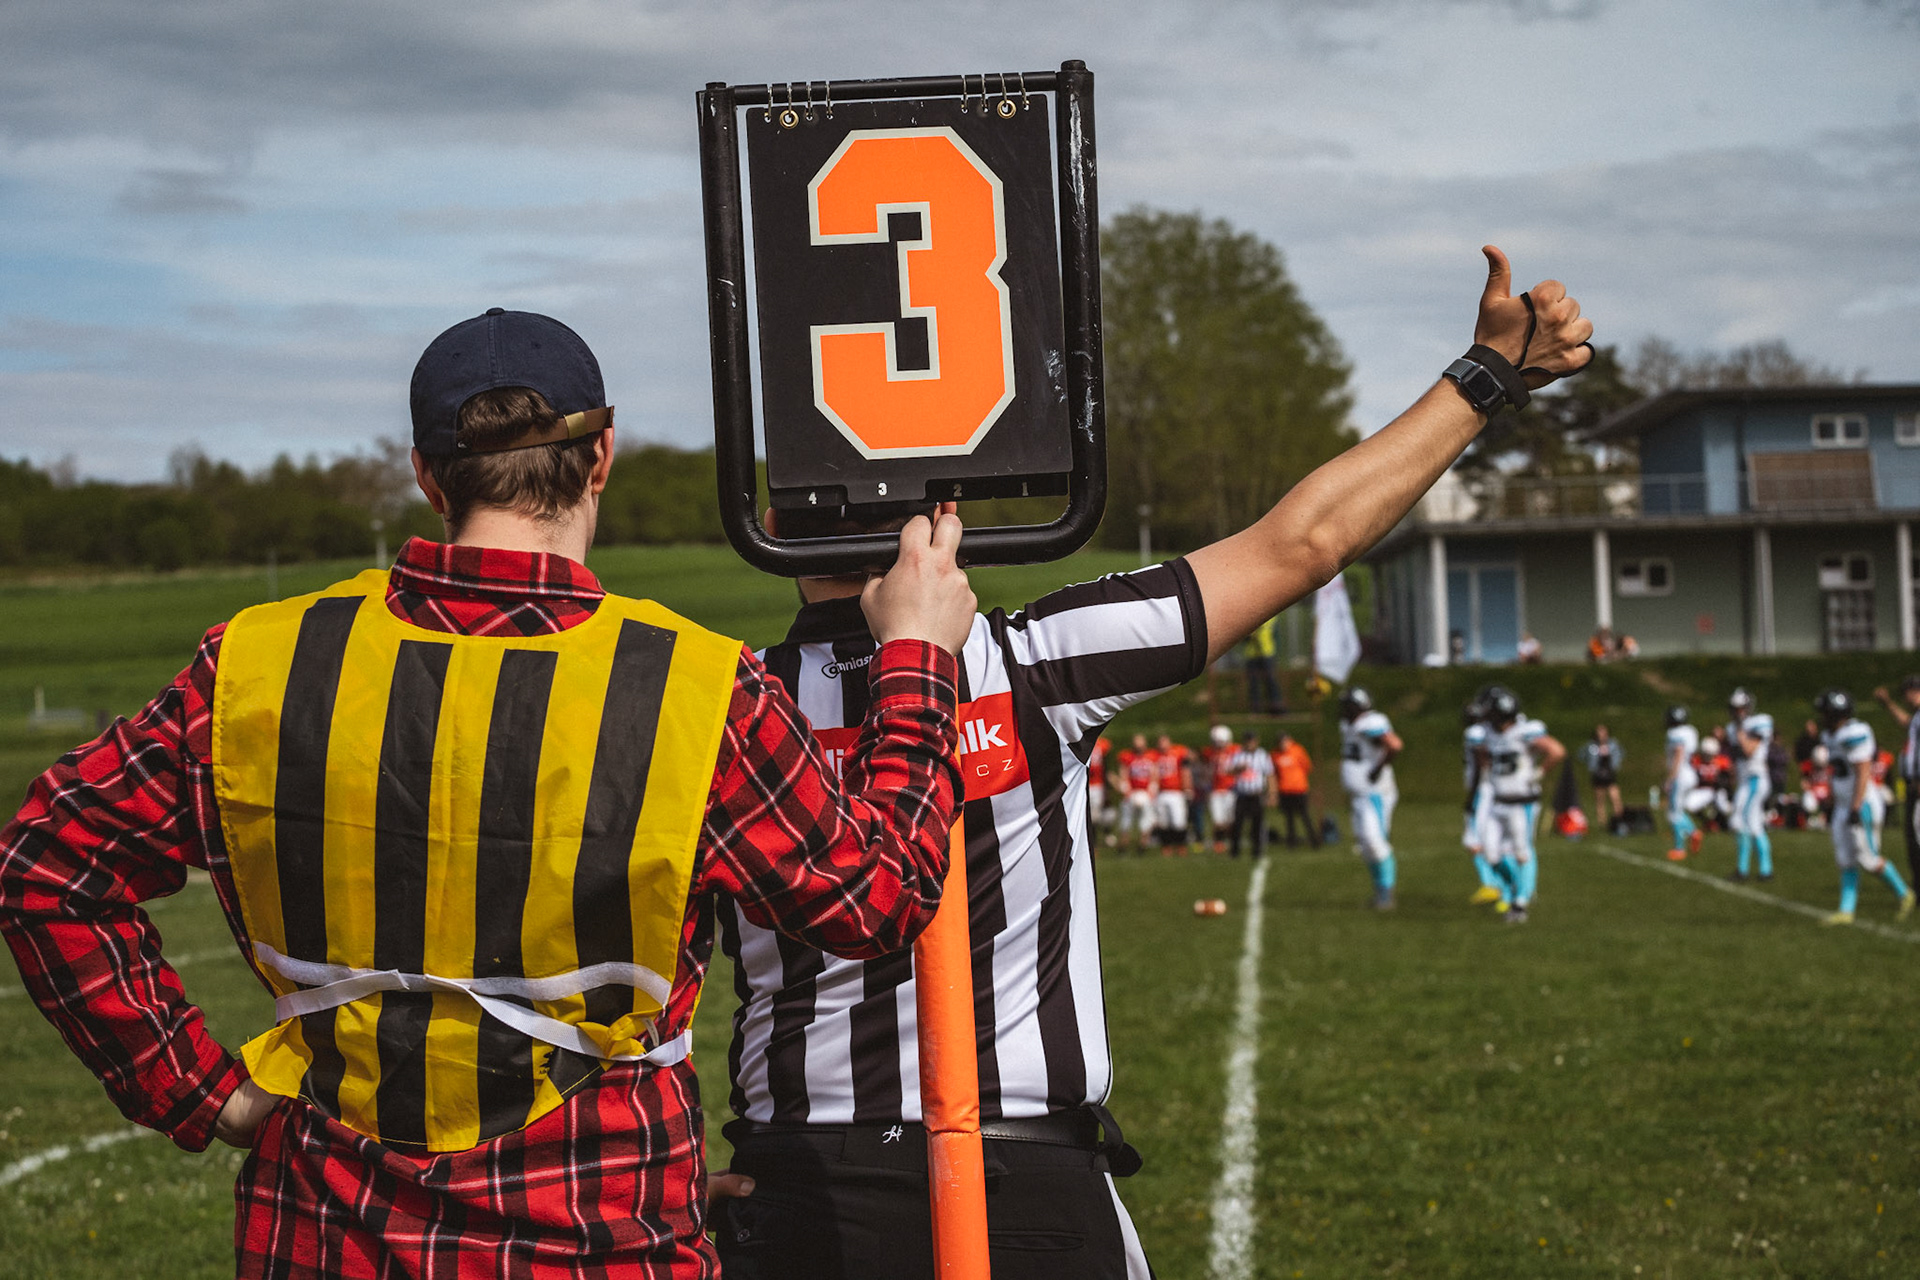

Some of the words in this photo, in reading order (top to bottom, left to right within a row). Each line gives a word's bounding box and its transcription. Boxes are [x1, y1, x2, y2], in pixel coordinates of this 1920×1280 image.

[808, 126, 1016, 460] 3
[808, 491, 818, 505] 4
[877, 482, 888, 496] 3
[953, 483, 963, 497] 2
[1021, 482, 1029, 496] 1
